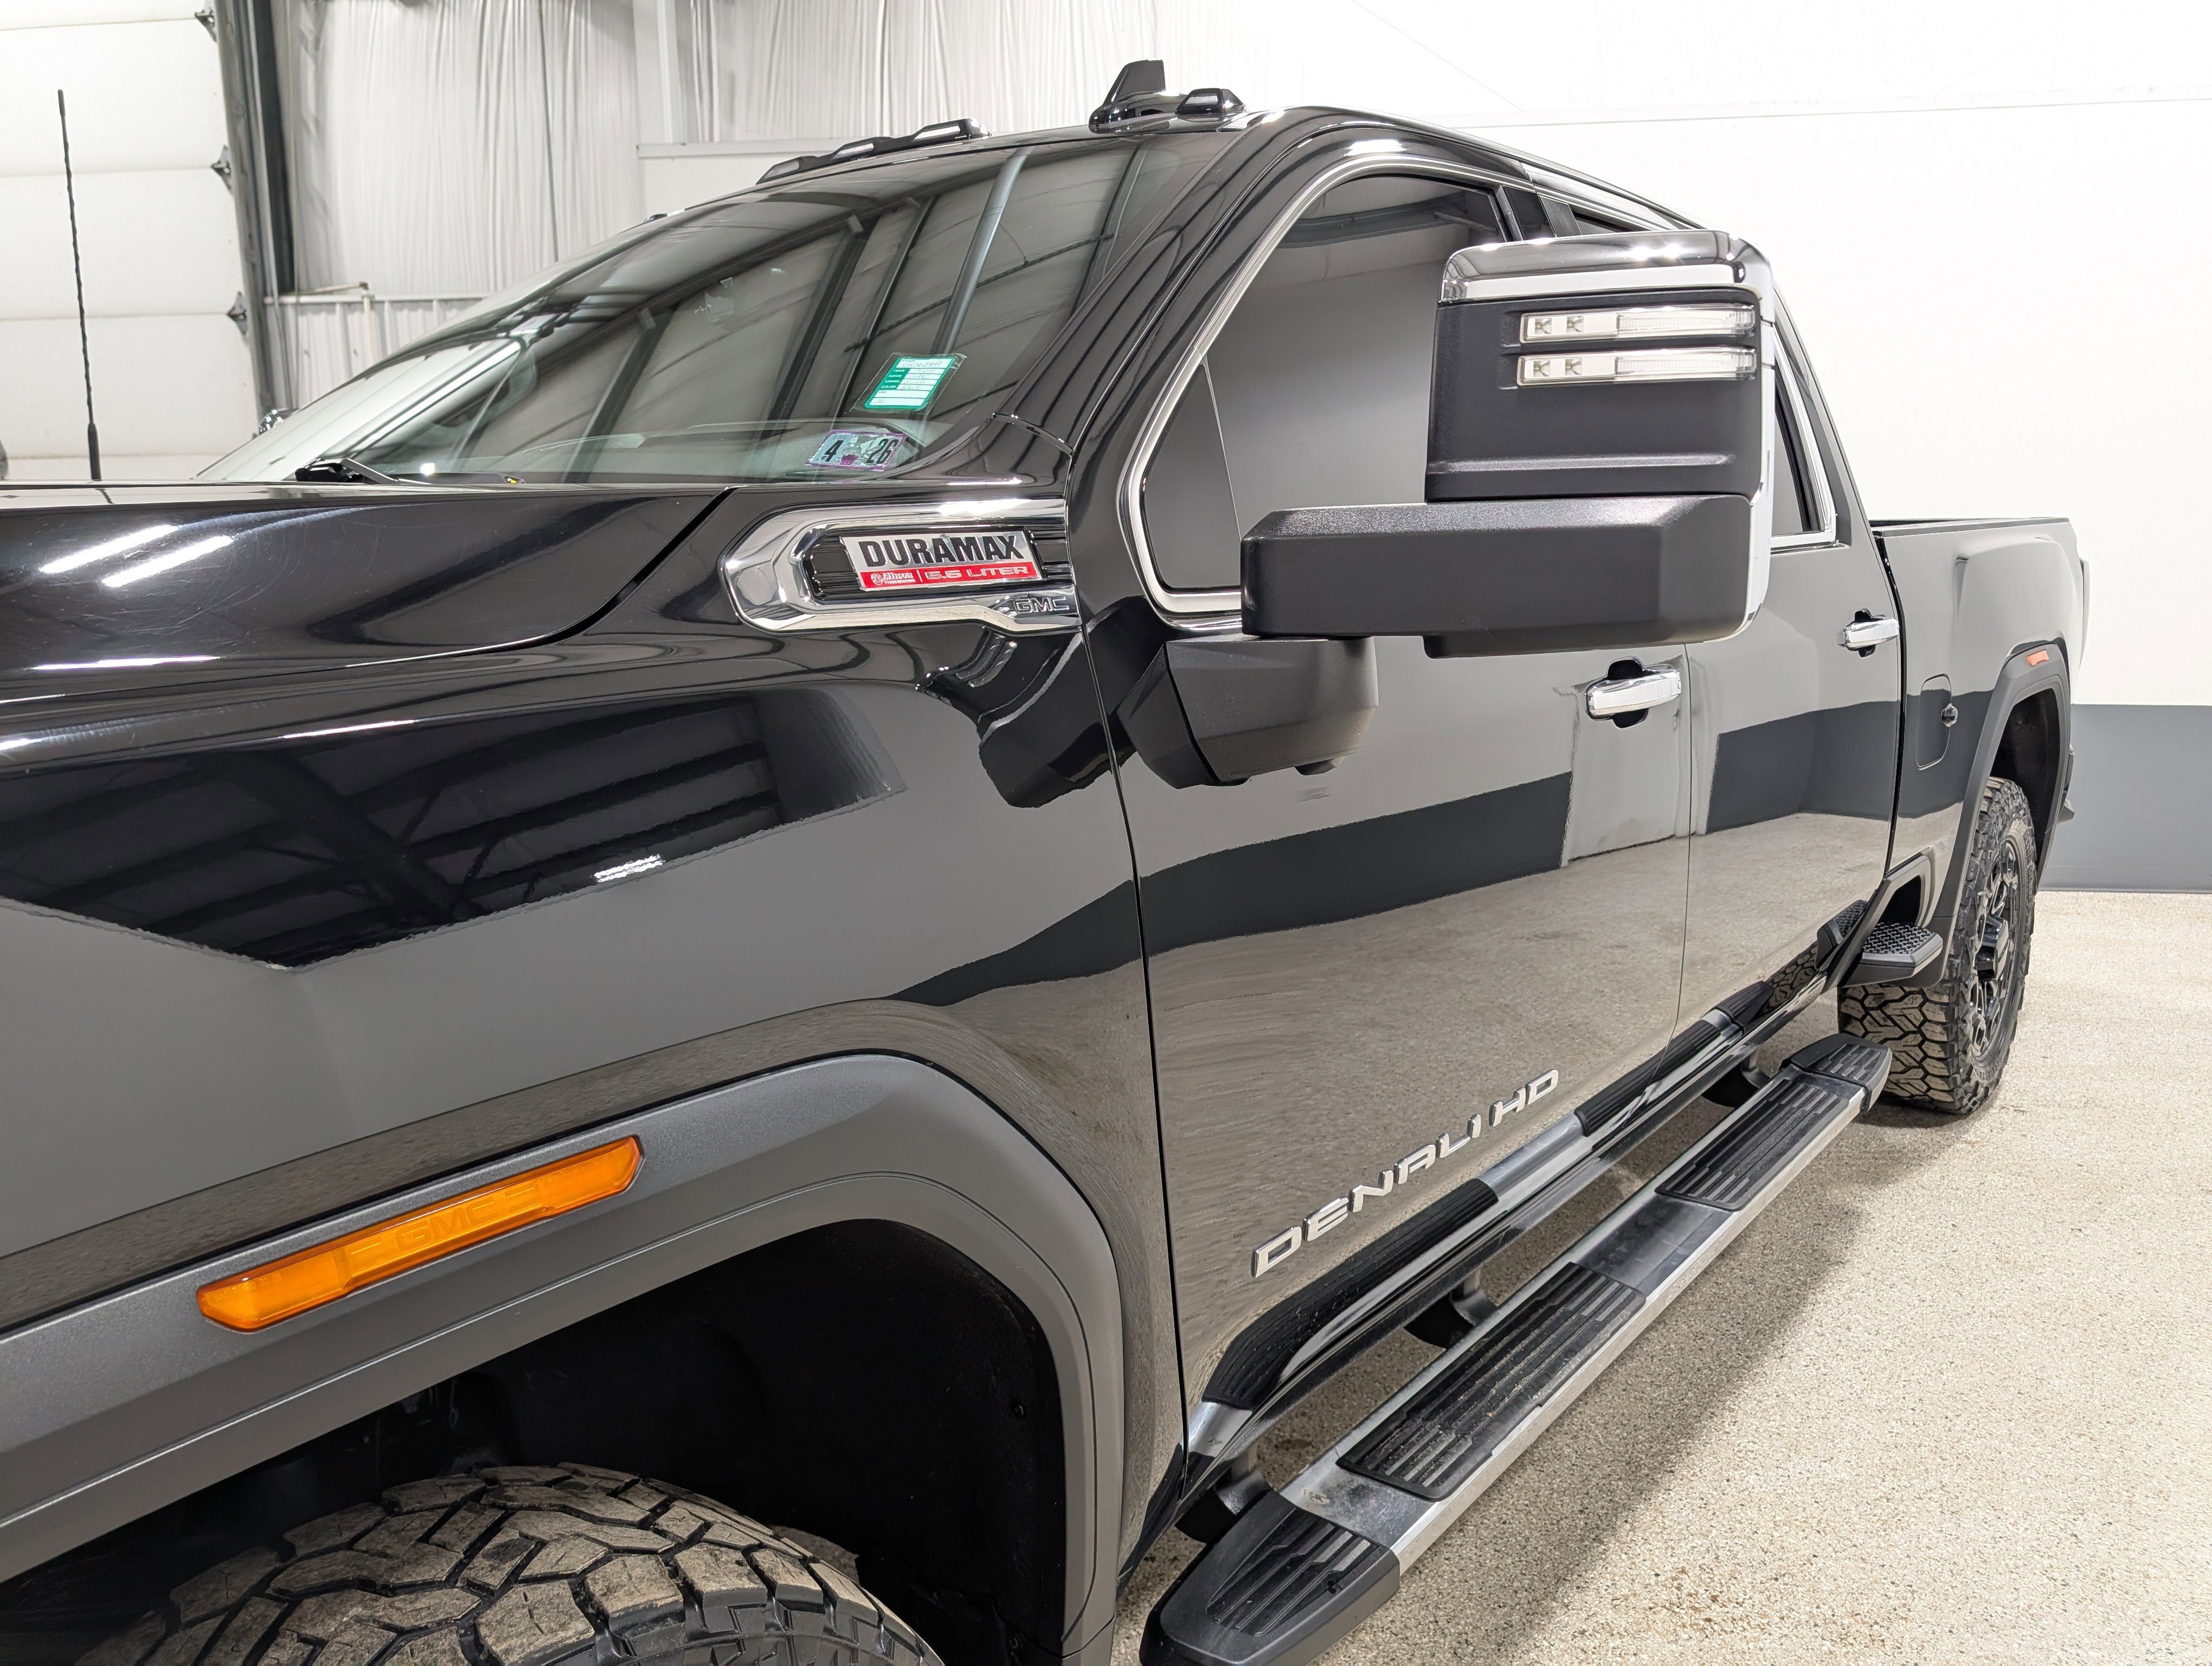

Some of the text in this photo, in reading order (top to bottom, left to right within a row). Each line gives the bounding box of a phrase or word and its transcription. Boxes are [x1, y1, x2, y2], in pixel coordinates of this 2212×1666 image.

[824, 440, 844, 462] 4
[866, 439, 899, 464] 26
[858, 535, 1025, 567] DURAMAX
[968, 566, 1029, 578] LITER
[1013, 596, 1070, 613] GMC
[1251, 1069, 1558, 1278] DENALI HD
[395, 1196, 495, 1252] GMC
